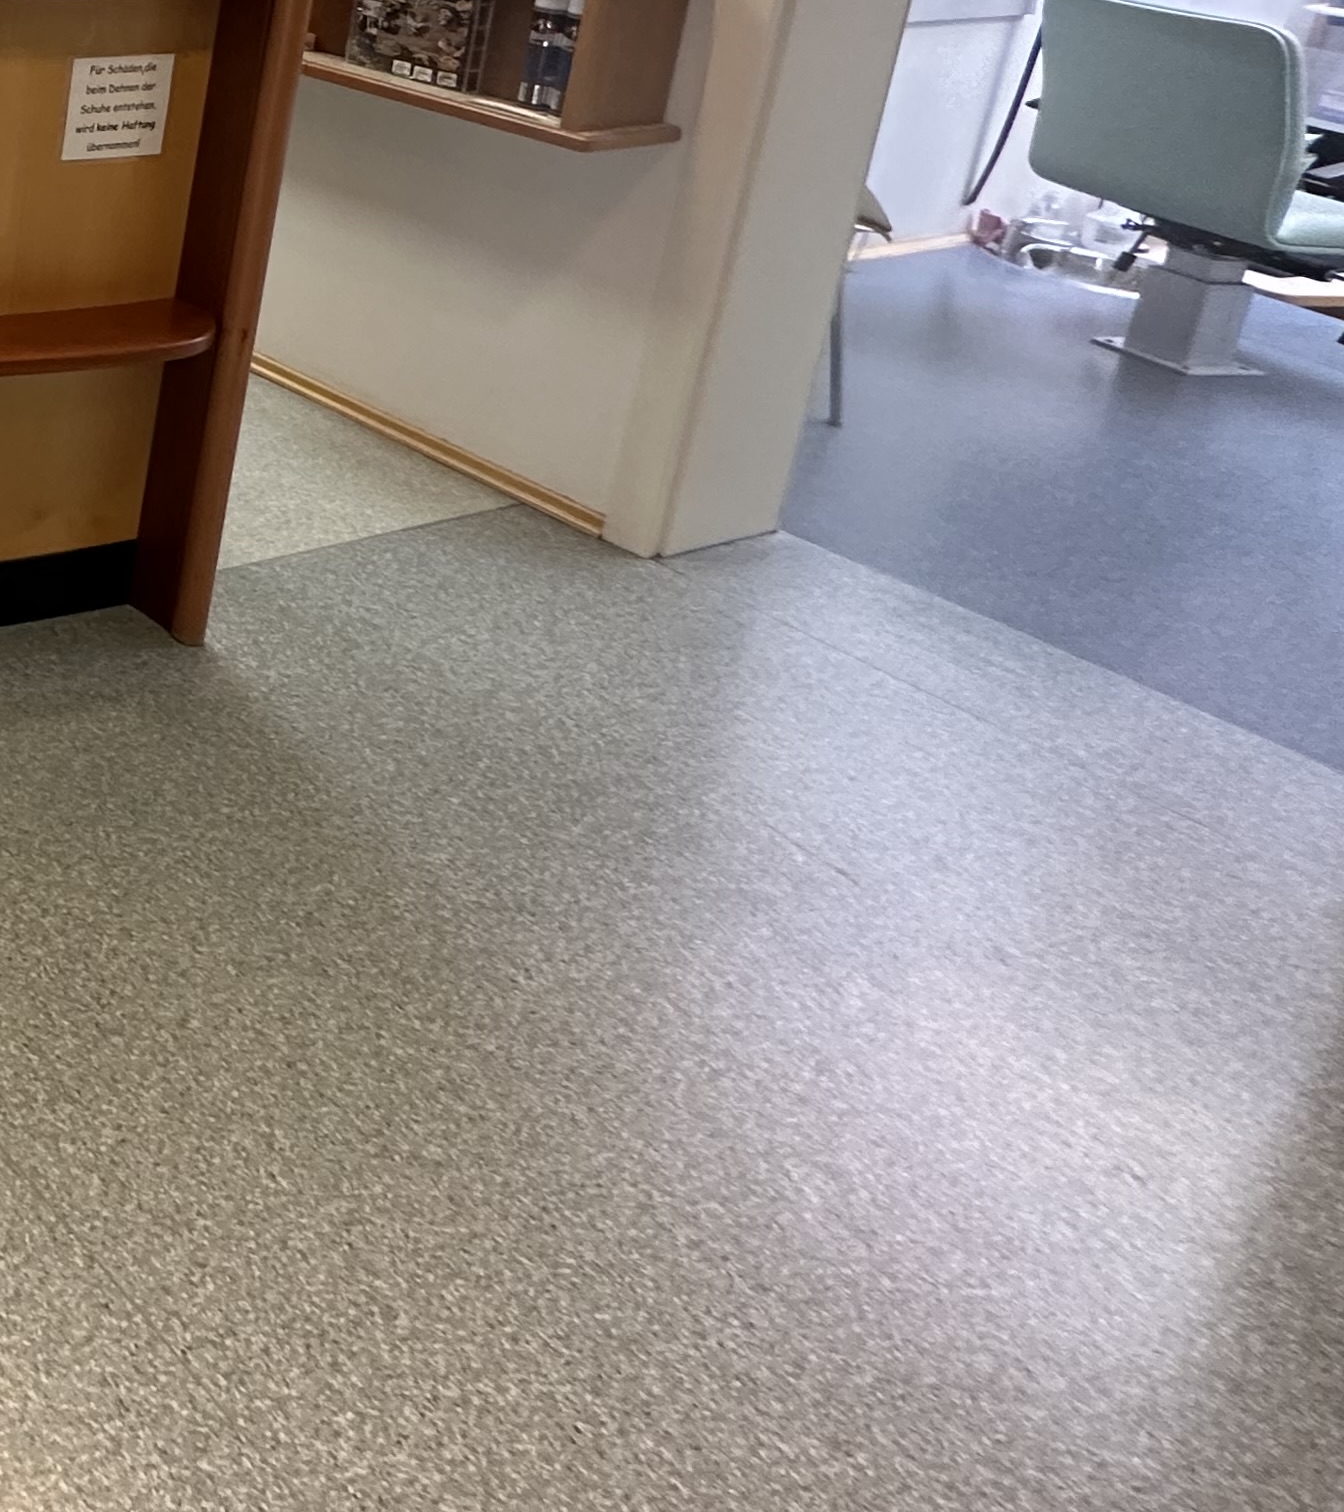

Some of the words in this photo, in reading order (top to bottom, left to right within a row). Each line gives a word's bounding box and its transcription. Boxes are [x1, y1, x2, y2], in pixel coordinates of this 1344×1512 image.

[89, 64, 106, 76] Für
[86, 85, 106, 95] beim
[141, 82, 156, 91] der
[80, 104, 111, 115] Schuhe
[75, 123, 95, 133] wird
[96, 123, 119, 132] keine
[121, 119, 156, 132] Haftung
